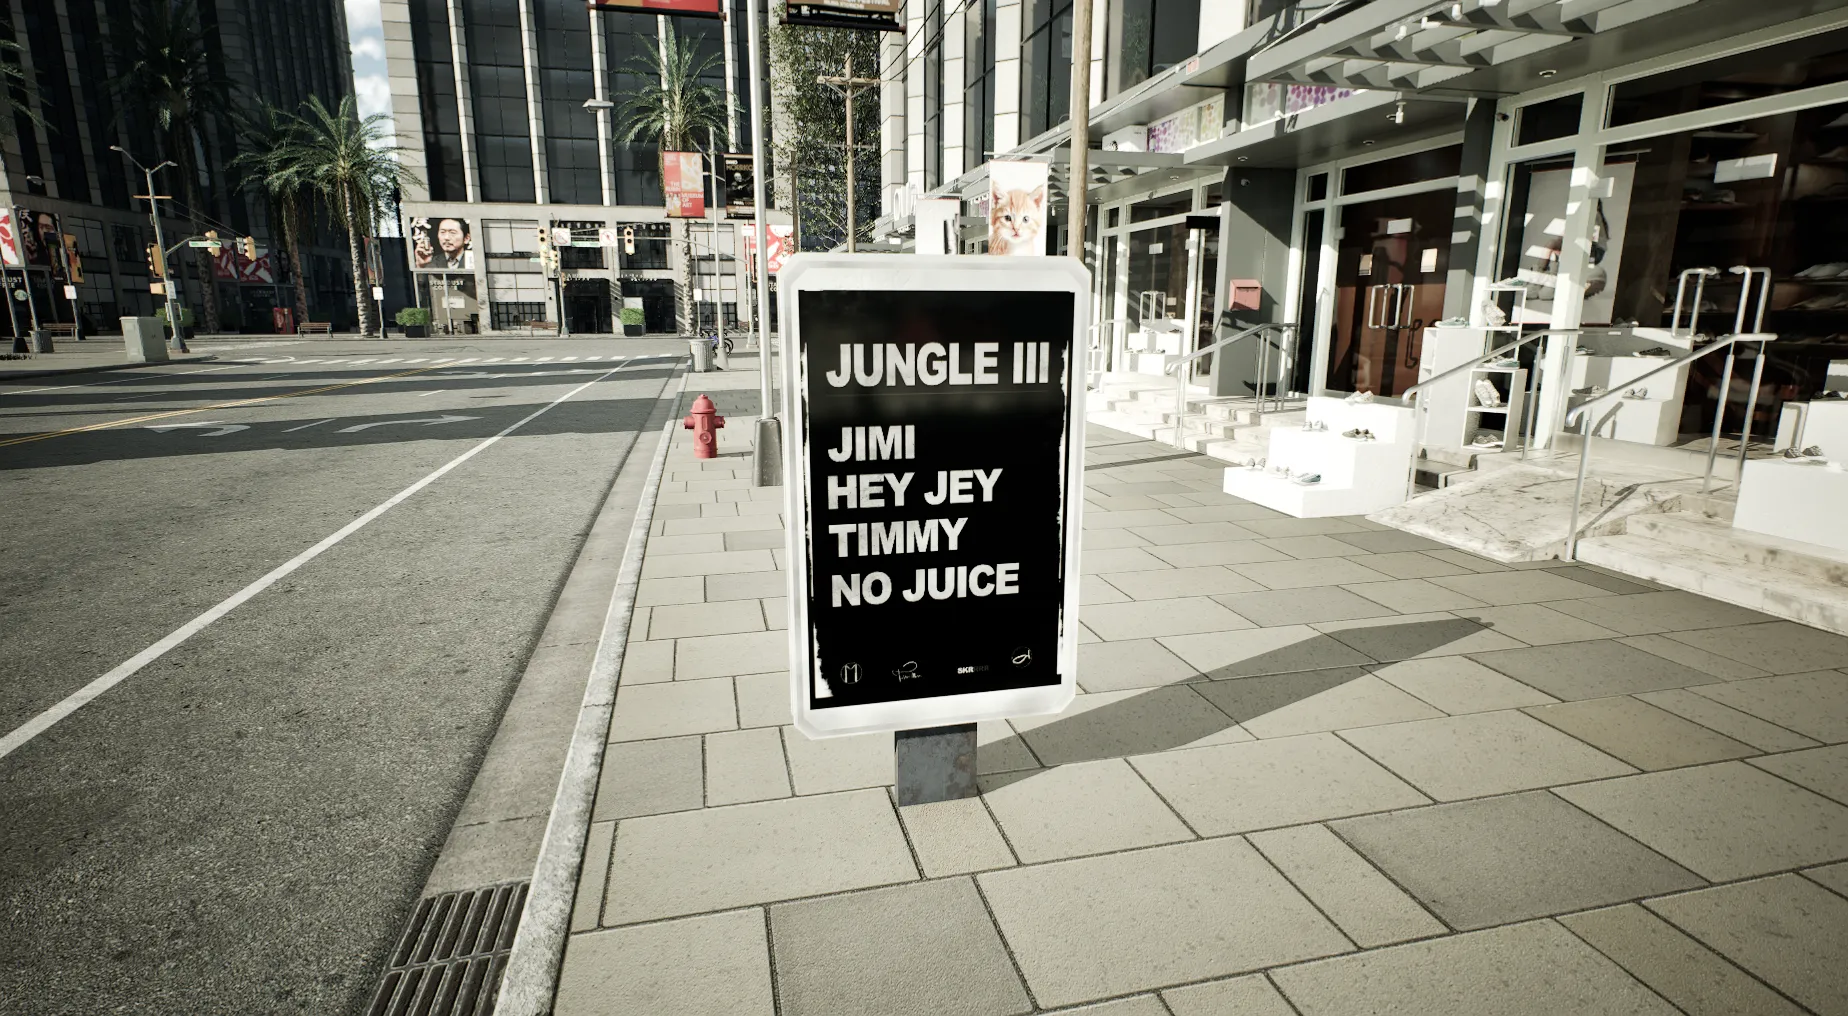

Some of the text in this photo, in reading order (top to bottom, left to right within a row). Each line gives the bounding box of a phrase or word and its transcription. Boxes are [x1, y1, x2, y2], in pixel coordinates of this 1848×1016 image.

[826, 342, 1049, 387] JUNGLE III
[828, 425, 915, 462] JIMI
[828, 469, 1003, 509] HEY JEY
[829, 518, 968, 557] TIMMY
[832, 563, 1020, 607] NO JUICE
